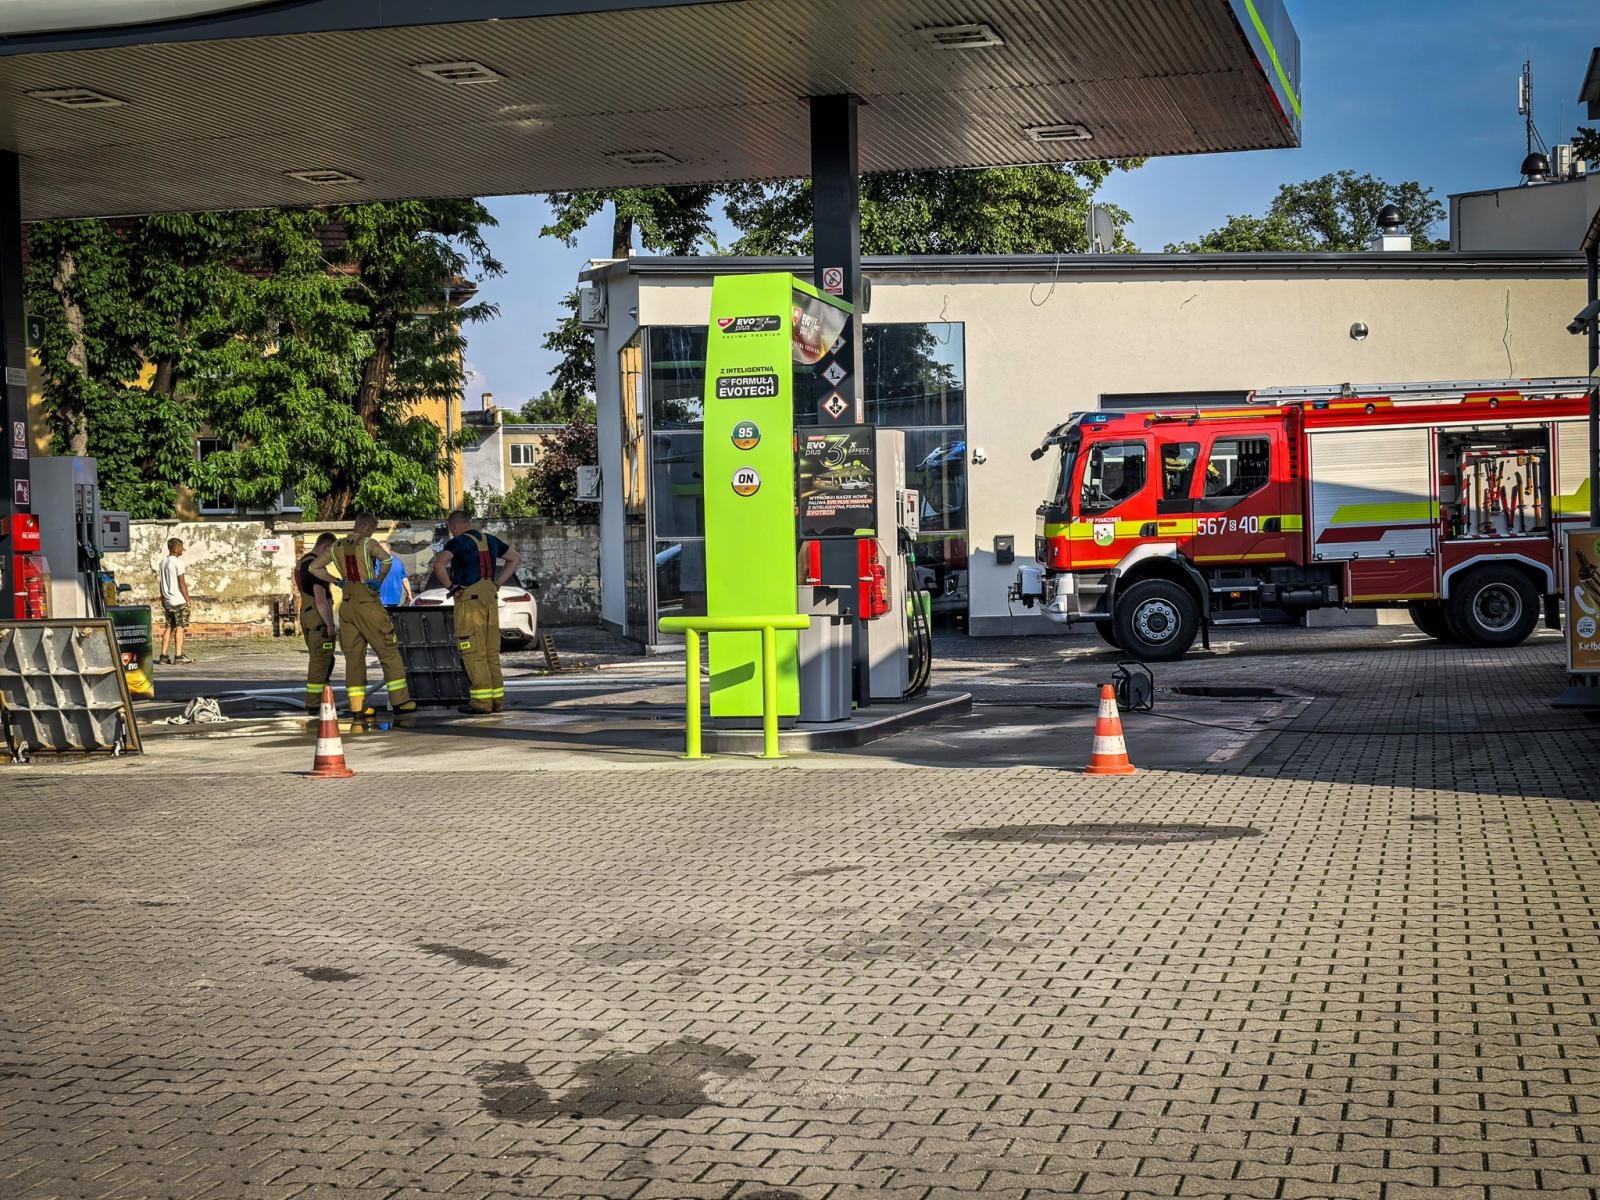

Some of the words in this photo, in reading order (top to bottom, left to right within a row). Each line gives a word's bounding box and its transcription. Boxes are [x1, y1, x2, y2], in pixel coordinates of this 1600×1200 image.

[32, 324, 40, 339] 3
[726, 366, 774, 374] INTELIGENTNĄ
[731, 377, 774, 385] FORMUŁĄ
[719, 385, 775, 397] EVOTECH
[738, 427, 753, 438] 95
[806, 441, 827, 449] EVO
[805, 448, 822, 456] plus
[738, 473, 754, 484] ON
[1197, 517, 1228, 536] 567
[1230, 520, 1237, 531] S
[1238, 516, 1258, 534] 40
